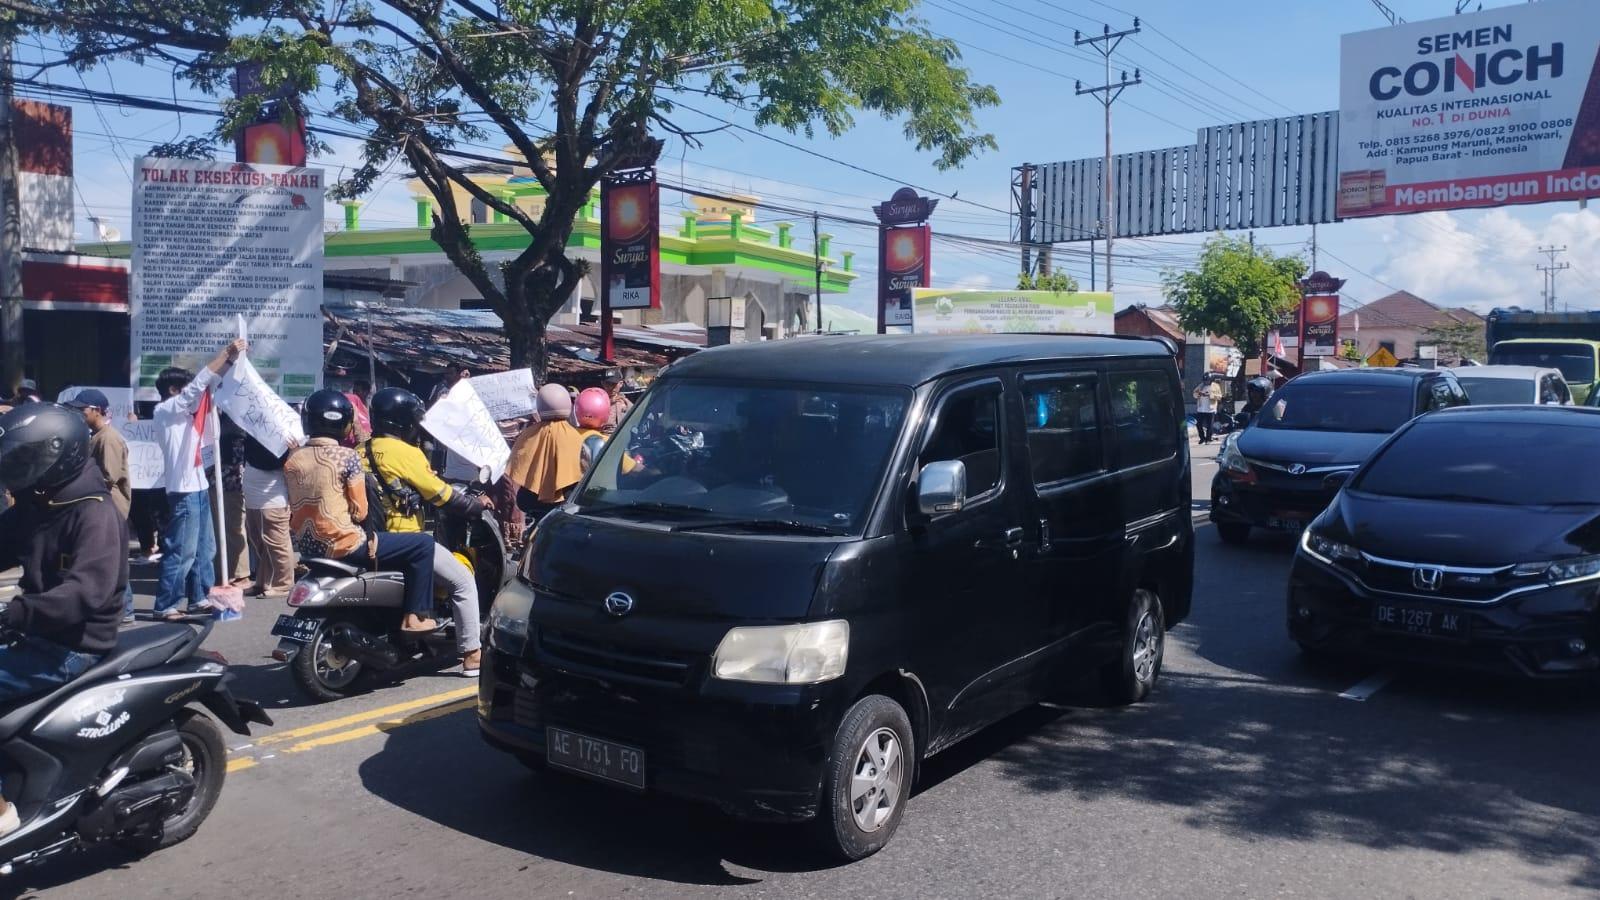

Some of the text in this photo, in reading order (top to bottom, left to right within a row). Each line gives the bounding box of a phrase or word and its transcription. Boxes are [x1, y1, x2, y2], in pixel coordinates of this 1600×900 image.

[1416, 23, 1513, 55] SEMEN
[1369, 41, 1564, 101] CONCH
[1376, 89, 1552, 120] KUALITAS INTERNASIONAL
[1412, 107, 1512, 128] NO. 1 DI DUNIA
[1358, 118, 1574, 151] Telp. 0813 5268 3976/0822 9100 0808
[1366, 148, 1388, 159] Add
[1396, 143, 1449, 156] Kampung
[1451, 137, 1493, 149] Maruni,
[1495, 129, 1563, 144] Manokwari,
[1395, 155, 1429, 166] Papua
[1432, 151, 1463, 161] Barat
[1472, 144, 1528, 157] Indonesia
[141, 167, 319, 189] TOLAK EKSEKUSI TANAH
[1395, 171, 1600, 207] Membangun Indo
[888, 203, 917, 217] Surya
[613, 248, 646, 266] Surya
[622, 291, 640, 300] RIKA
[1378, 606, 1395, 623] DE
[1401, 608, 1433, 627] 1267
[1441, 613, 1459, 631] AK
[76, 710, 131, 738] STROLLING
[553, 731, 570, 755] AE
[578, 737, 611, 767] 1751
